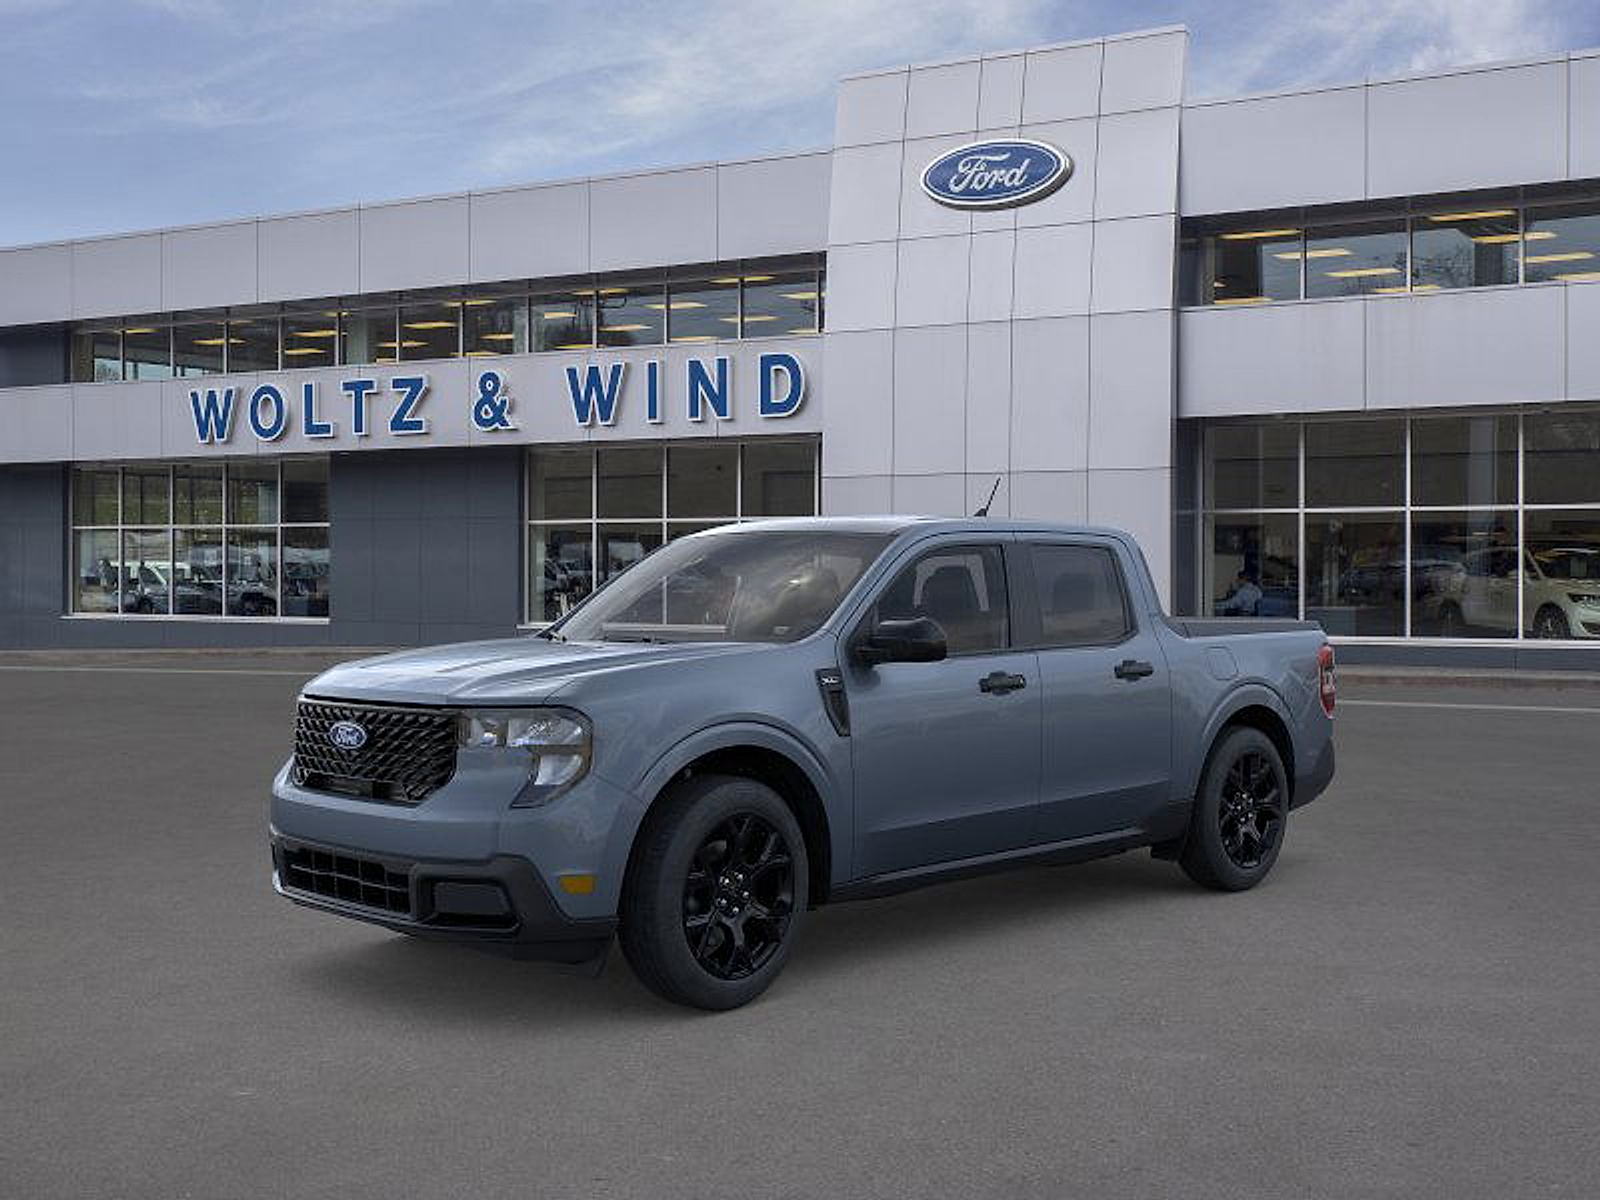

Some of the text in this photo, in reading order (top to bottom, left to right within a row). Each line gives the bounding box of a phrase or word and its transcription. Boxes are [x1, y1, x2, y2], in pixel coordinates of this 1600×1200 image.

[949, 152, 1031, 193] Ford
[191, 353, 804, 442] WOLTZ & WIND
